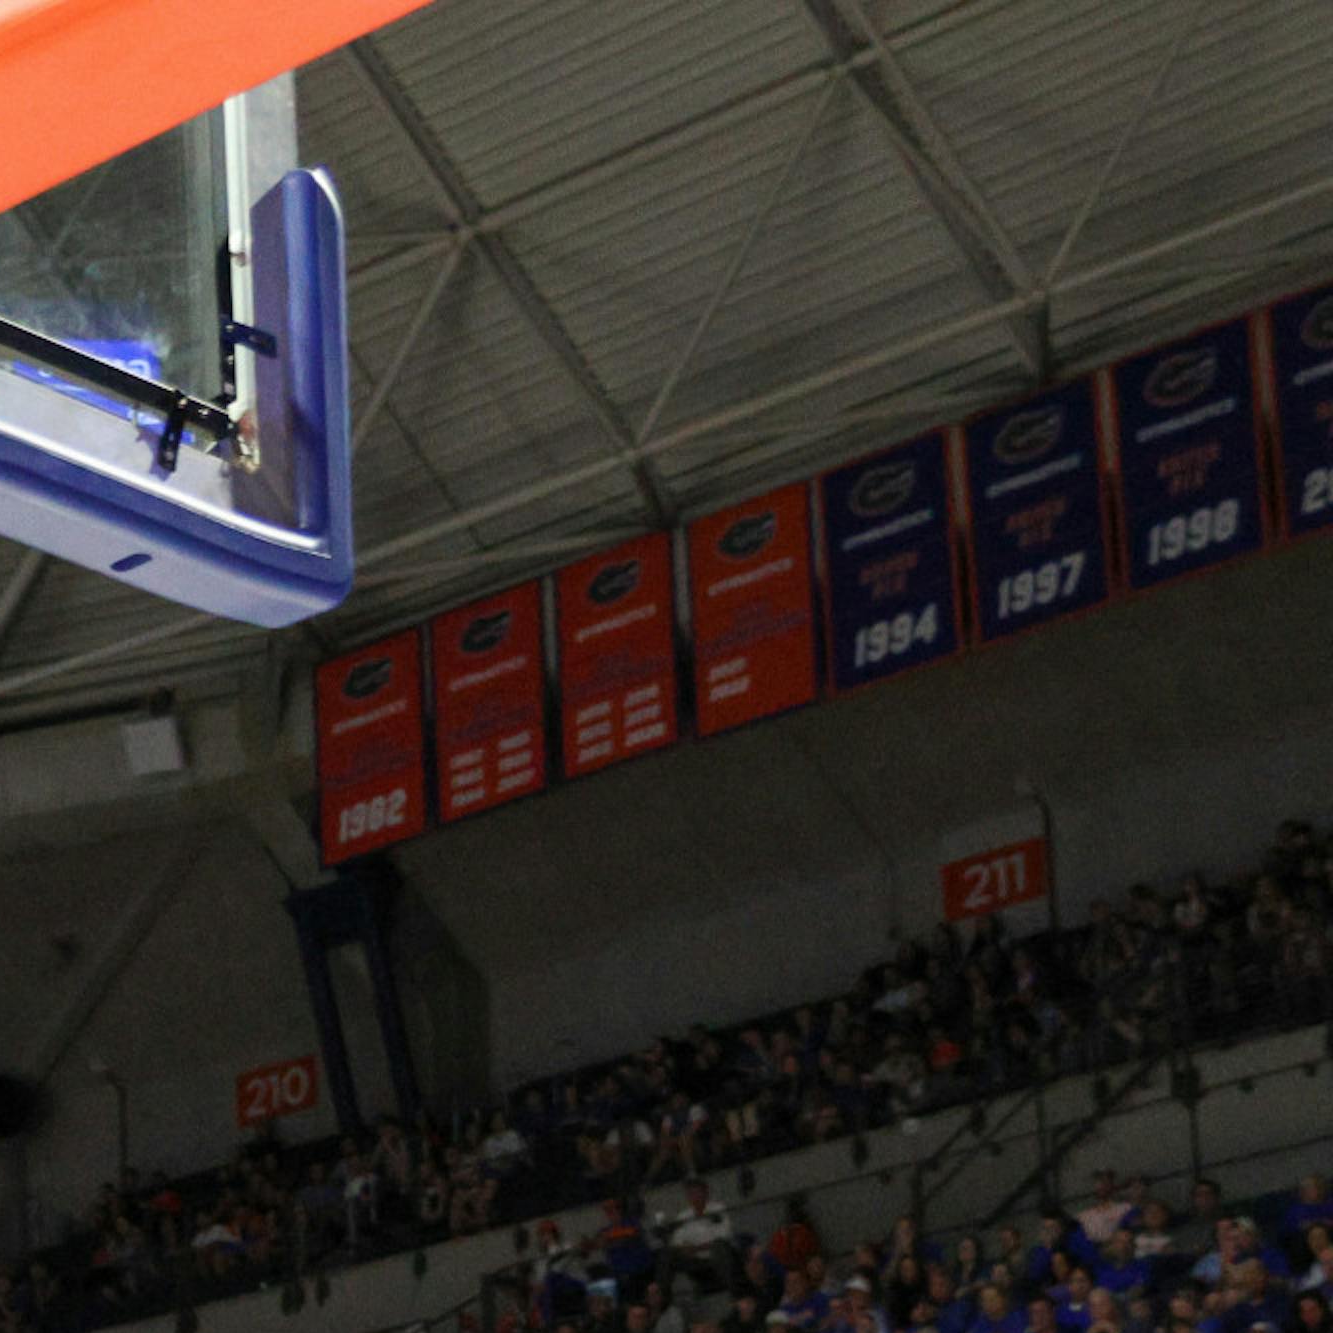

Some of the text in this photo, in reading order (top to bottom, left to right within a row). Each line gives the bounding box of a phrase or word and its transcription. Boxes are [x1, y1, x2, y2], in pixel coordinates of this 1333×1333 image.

[998, 551, 1086, 620] 1997
[854, 603, 937, 669] 1994
[962, 851, 1026, 910] 211
[244, 1064, 310, 1118] 210
